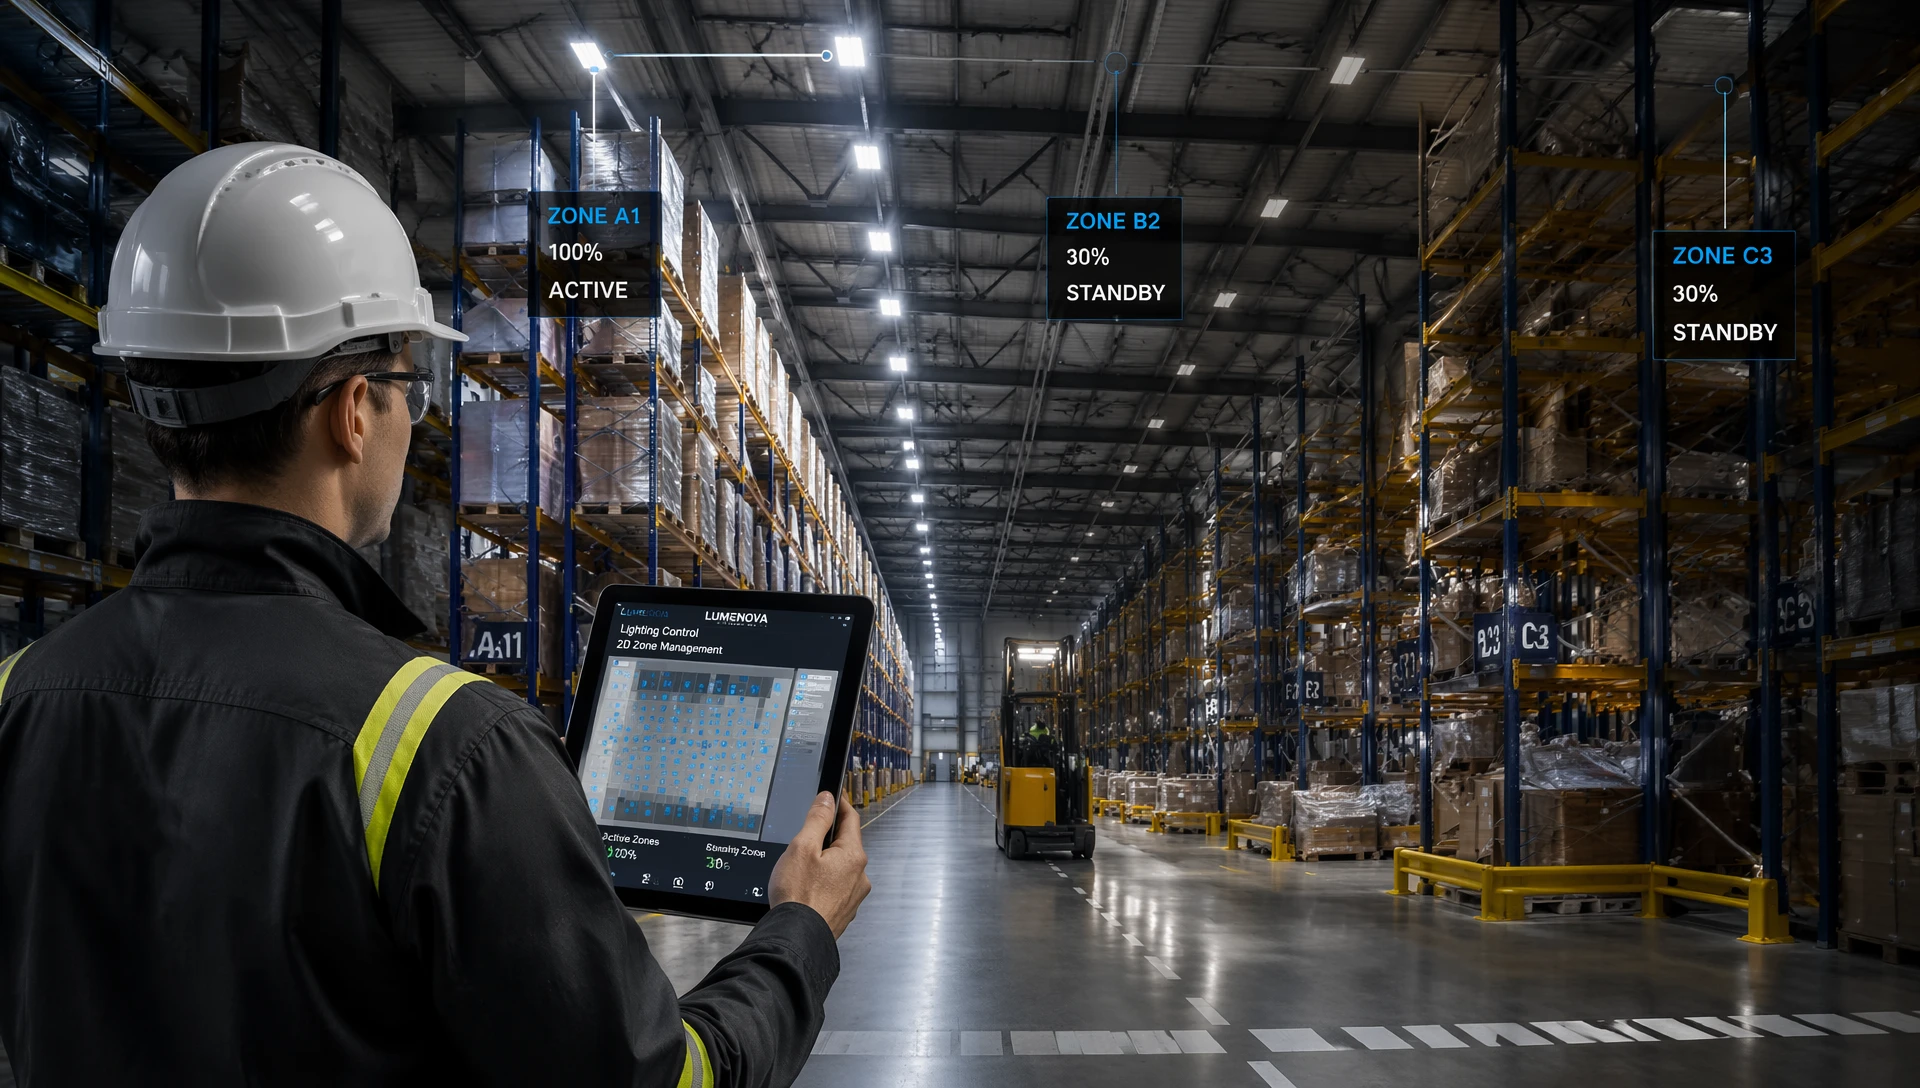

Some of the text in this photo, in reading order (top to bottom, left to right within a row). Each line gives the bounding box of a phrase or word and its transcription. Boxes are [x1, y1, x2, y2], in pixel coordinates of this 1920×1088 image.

[704, 610, 769, 625] LUMENOVA
[620, 623, 700, 638] Lighting Control
[1521, 621, 1550, 650] C3
[616, 639, 724, 656] 2D Zone Management
[632, 834, 660, 847] Zones
